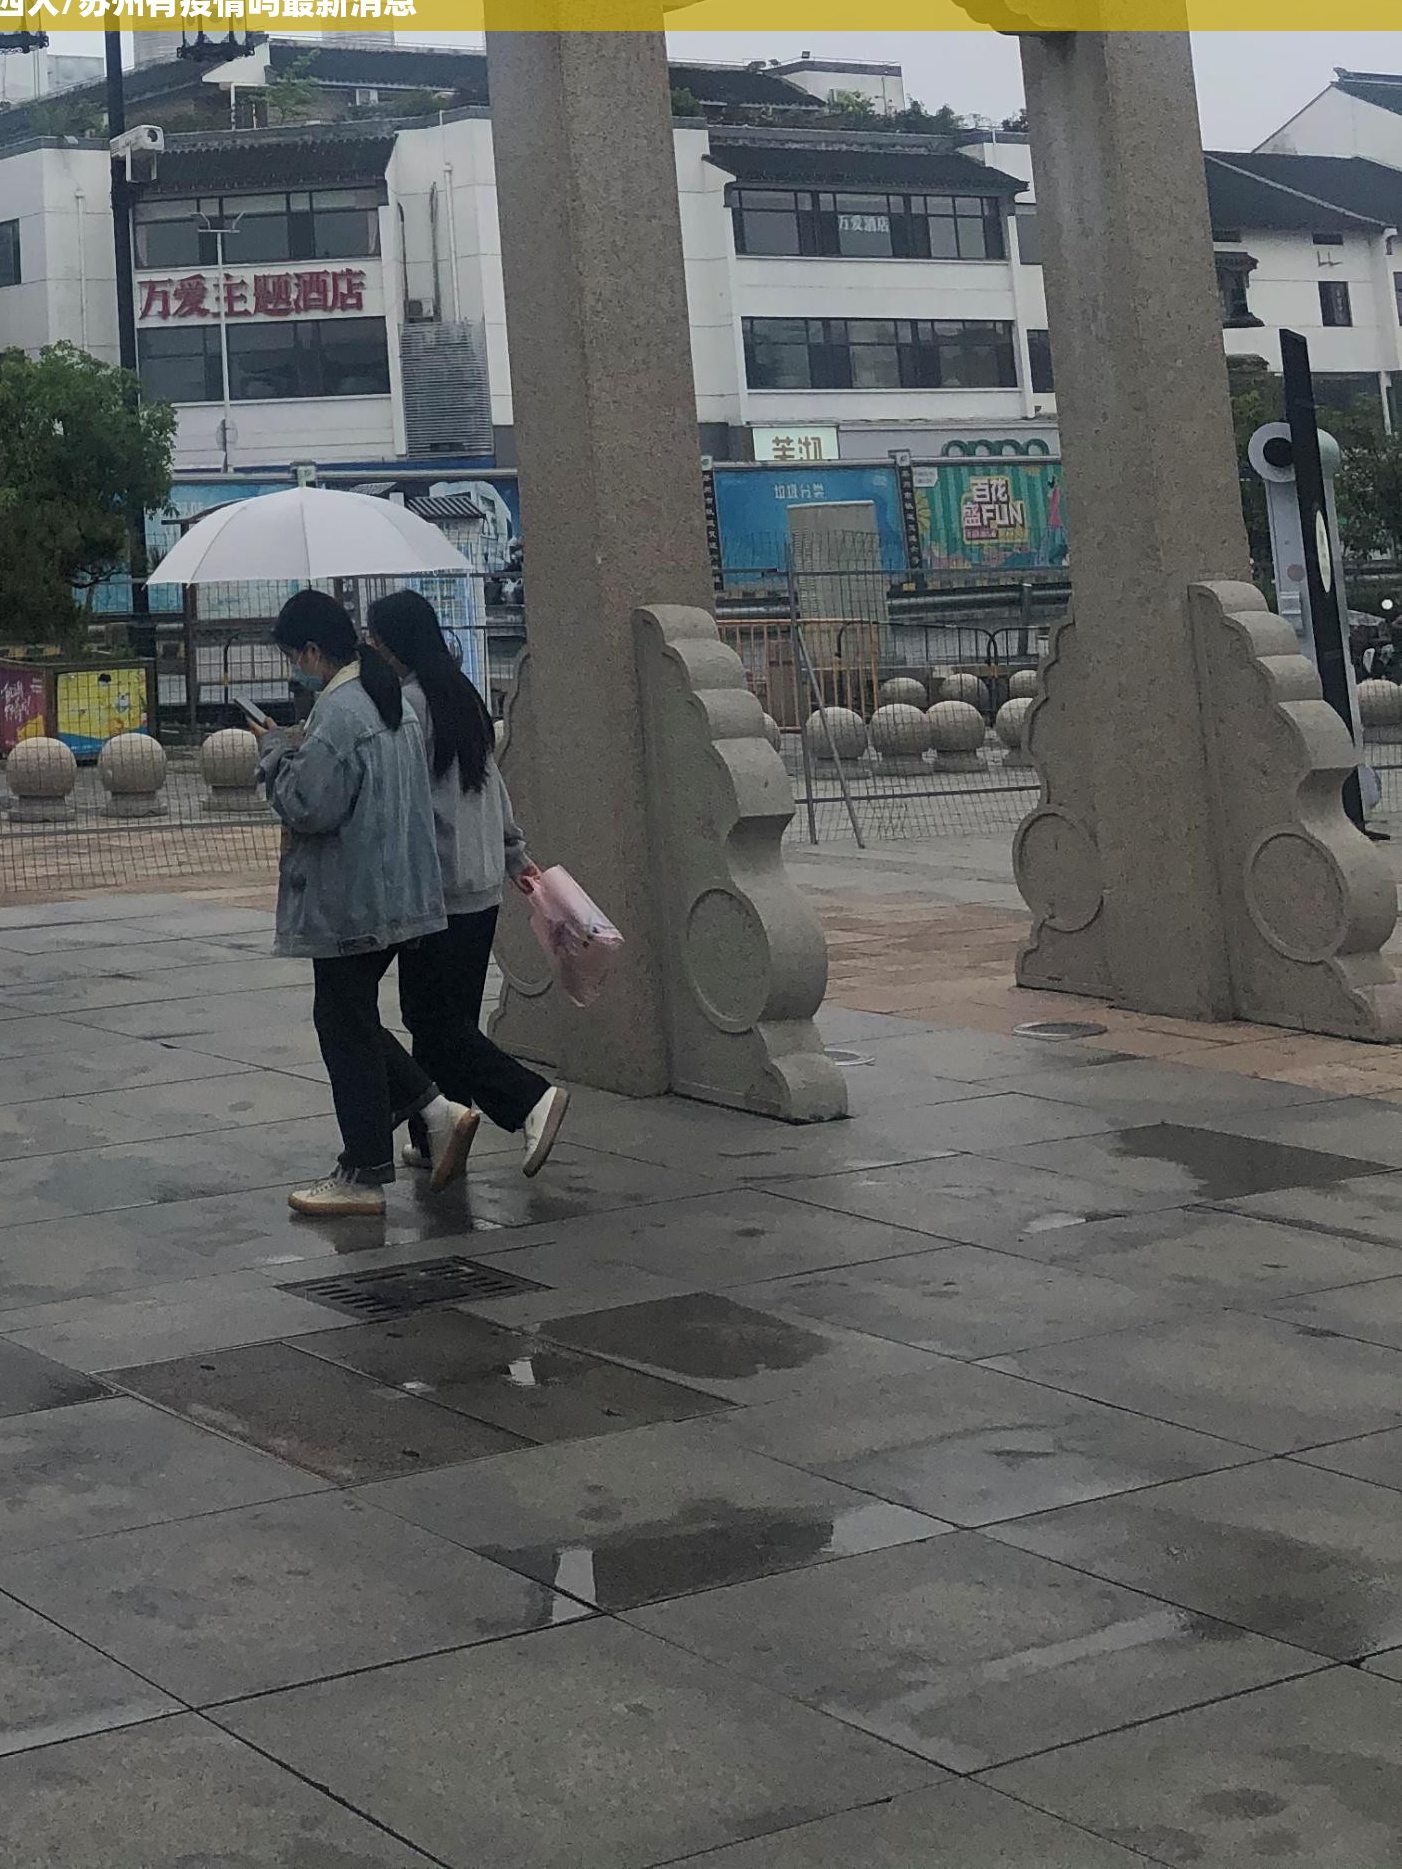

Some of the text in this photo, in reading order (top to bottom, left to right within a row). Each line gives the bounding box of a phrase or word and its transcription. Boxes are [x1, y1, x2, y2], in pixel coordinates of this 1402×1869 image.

[139, 268, 366, 320] 万爱主题酒店
[971, 478, 1009, 503] 百花
